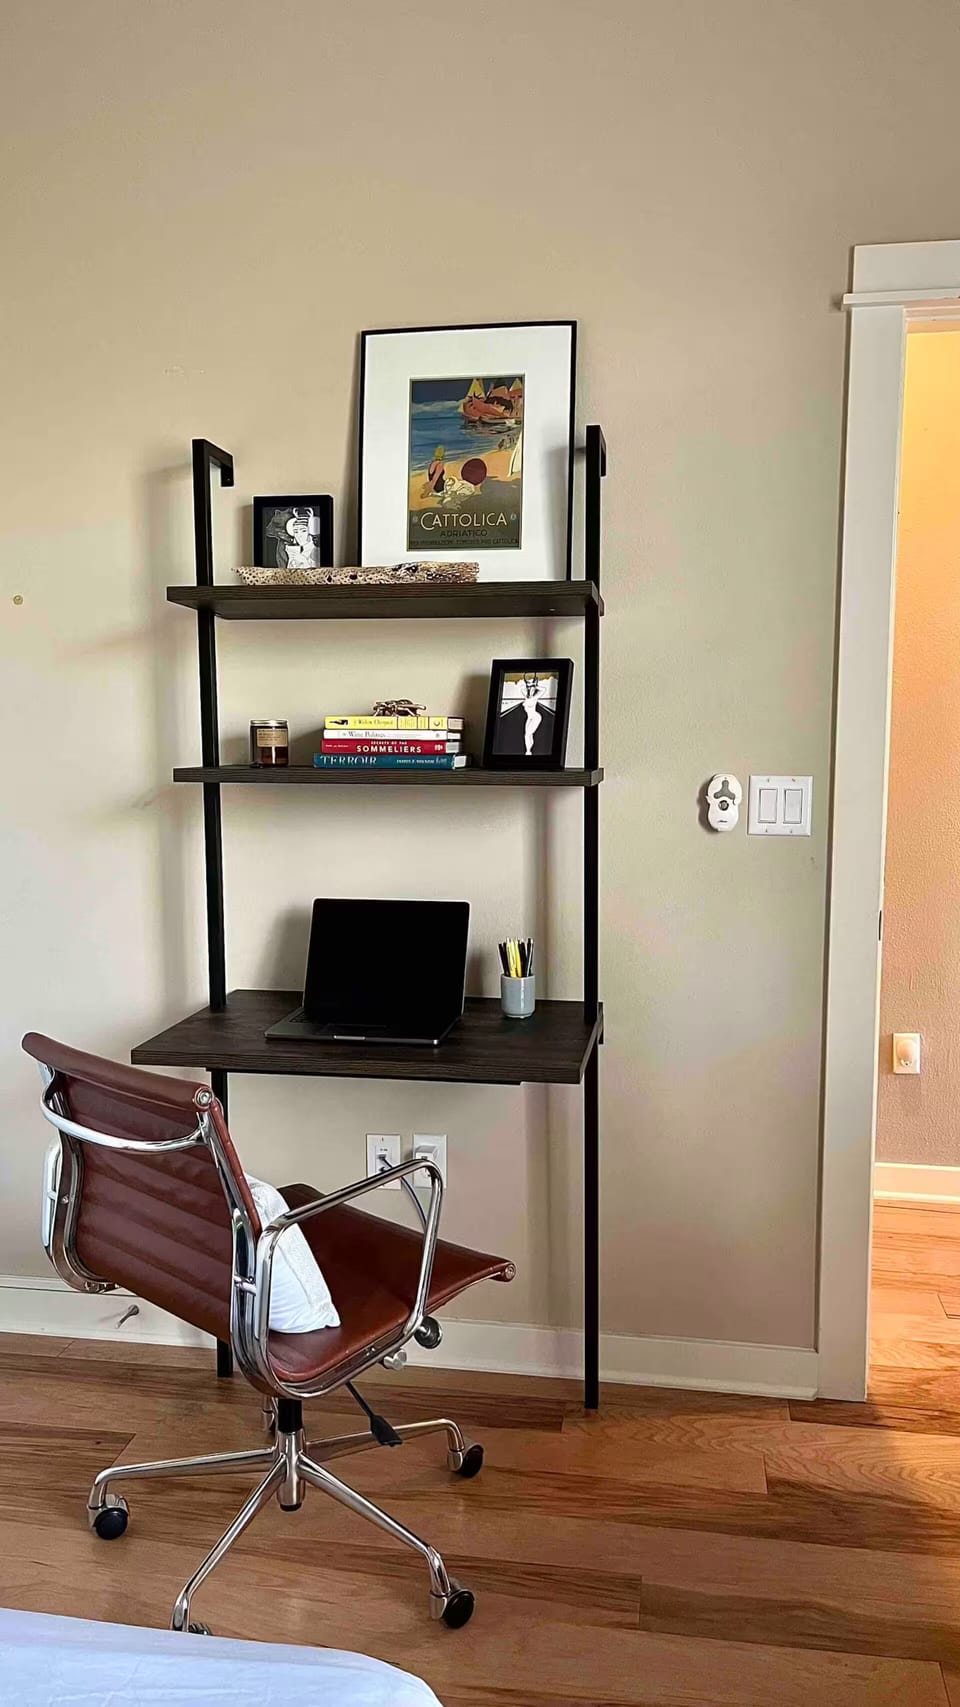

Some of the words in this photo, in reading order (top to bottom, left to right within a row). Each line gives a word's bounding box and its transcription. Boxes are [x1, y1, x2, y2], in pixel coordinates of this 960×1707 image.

[420, 512, 507, 530] CATTOLICA
[440, 529, 488, 537] ADRIATICO
[356, 745, 422, 753] SOMMELIERS
[320, 755, 377, 765] TERROIR
